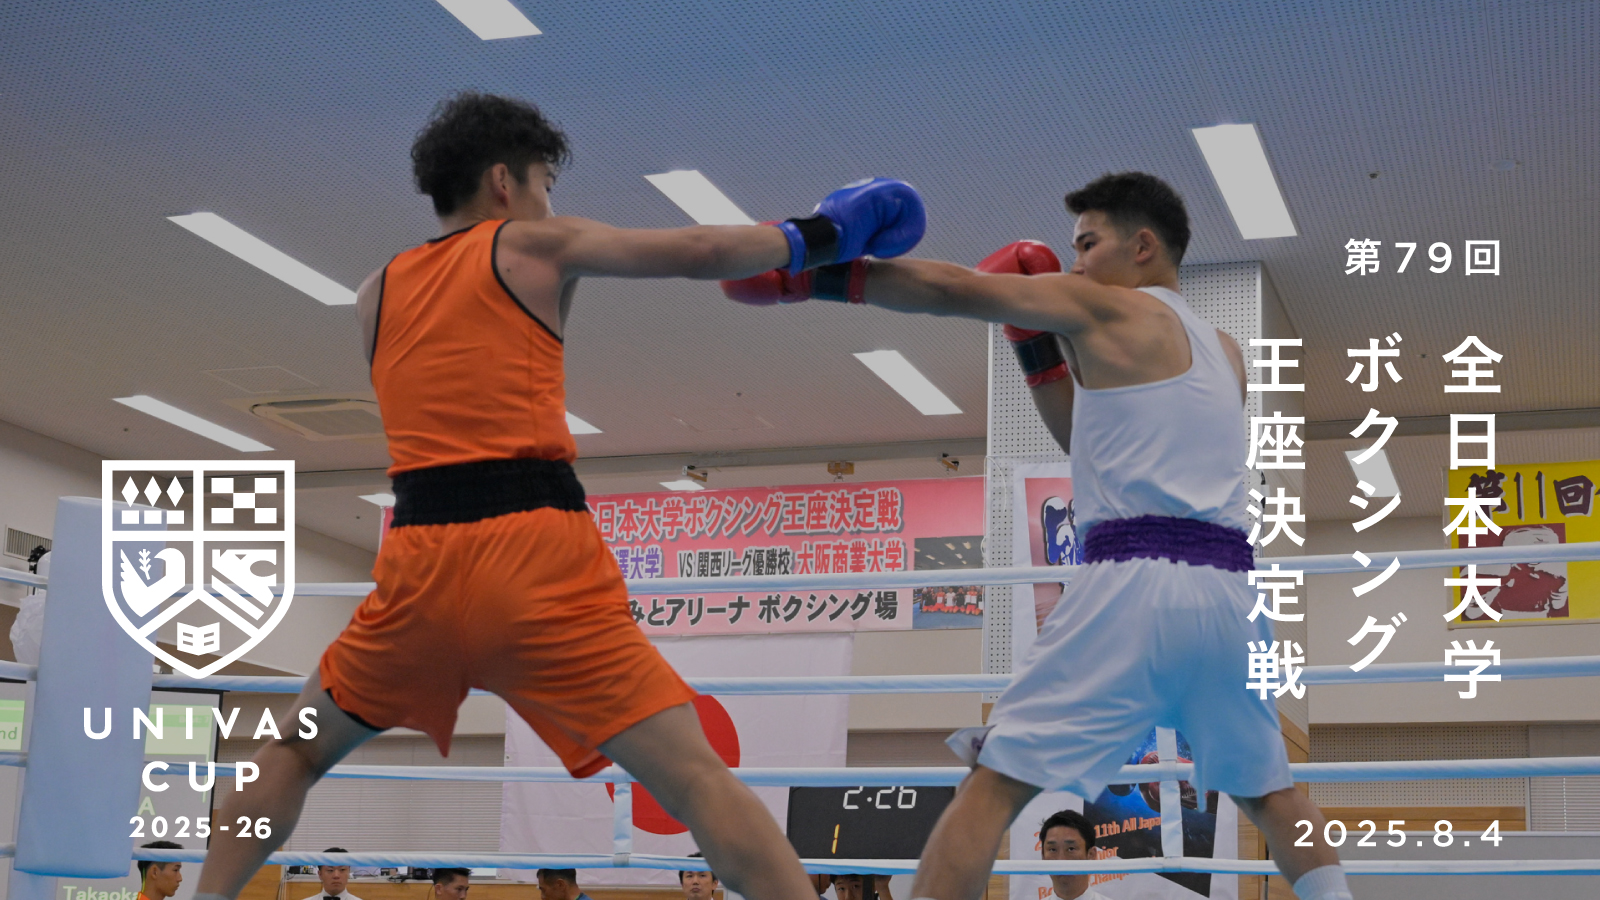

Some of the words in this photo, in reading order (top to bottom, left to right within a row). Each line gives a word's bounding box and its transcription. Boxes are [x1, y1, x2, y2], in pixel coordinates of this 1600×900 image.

[1465, 469, 1600, 520] 第11回
[586, 488, 902, 541] 日本大学ボクシング王座決定戦
[679, 551, 693, 578] VS
[797, 539, 903, 575] 大阪商業大学
[758, 590, 899, 624] ボクシング場
[1094, 820, 1121, 838] 11th
[1122, 816, 1137, 833] All
